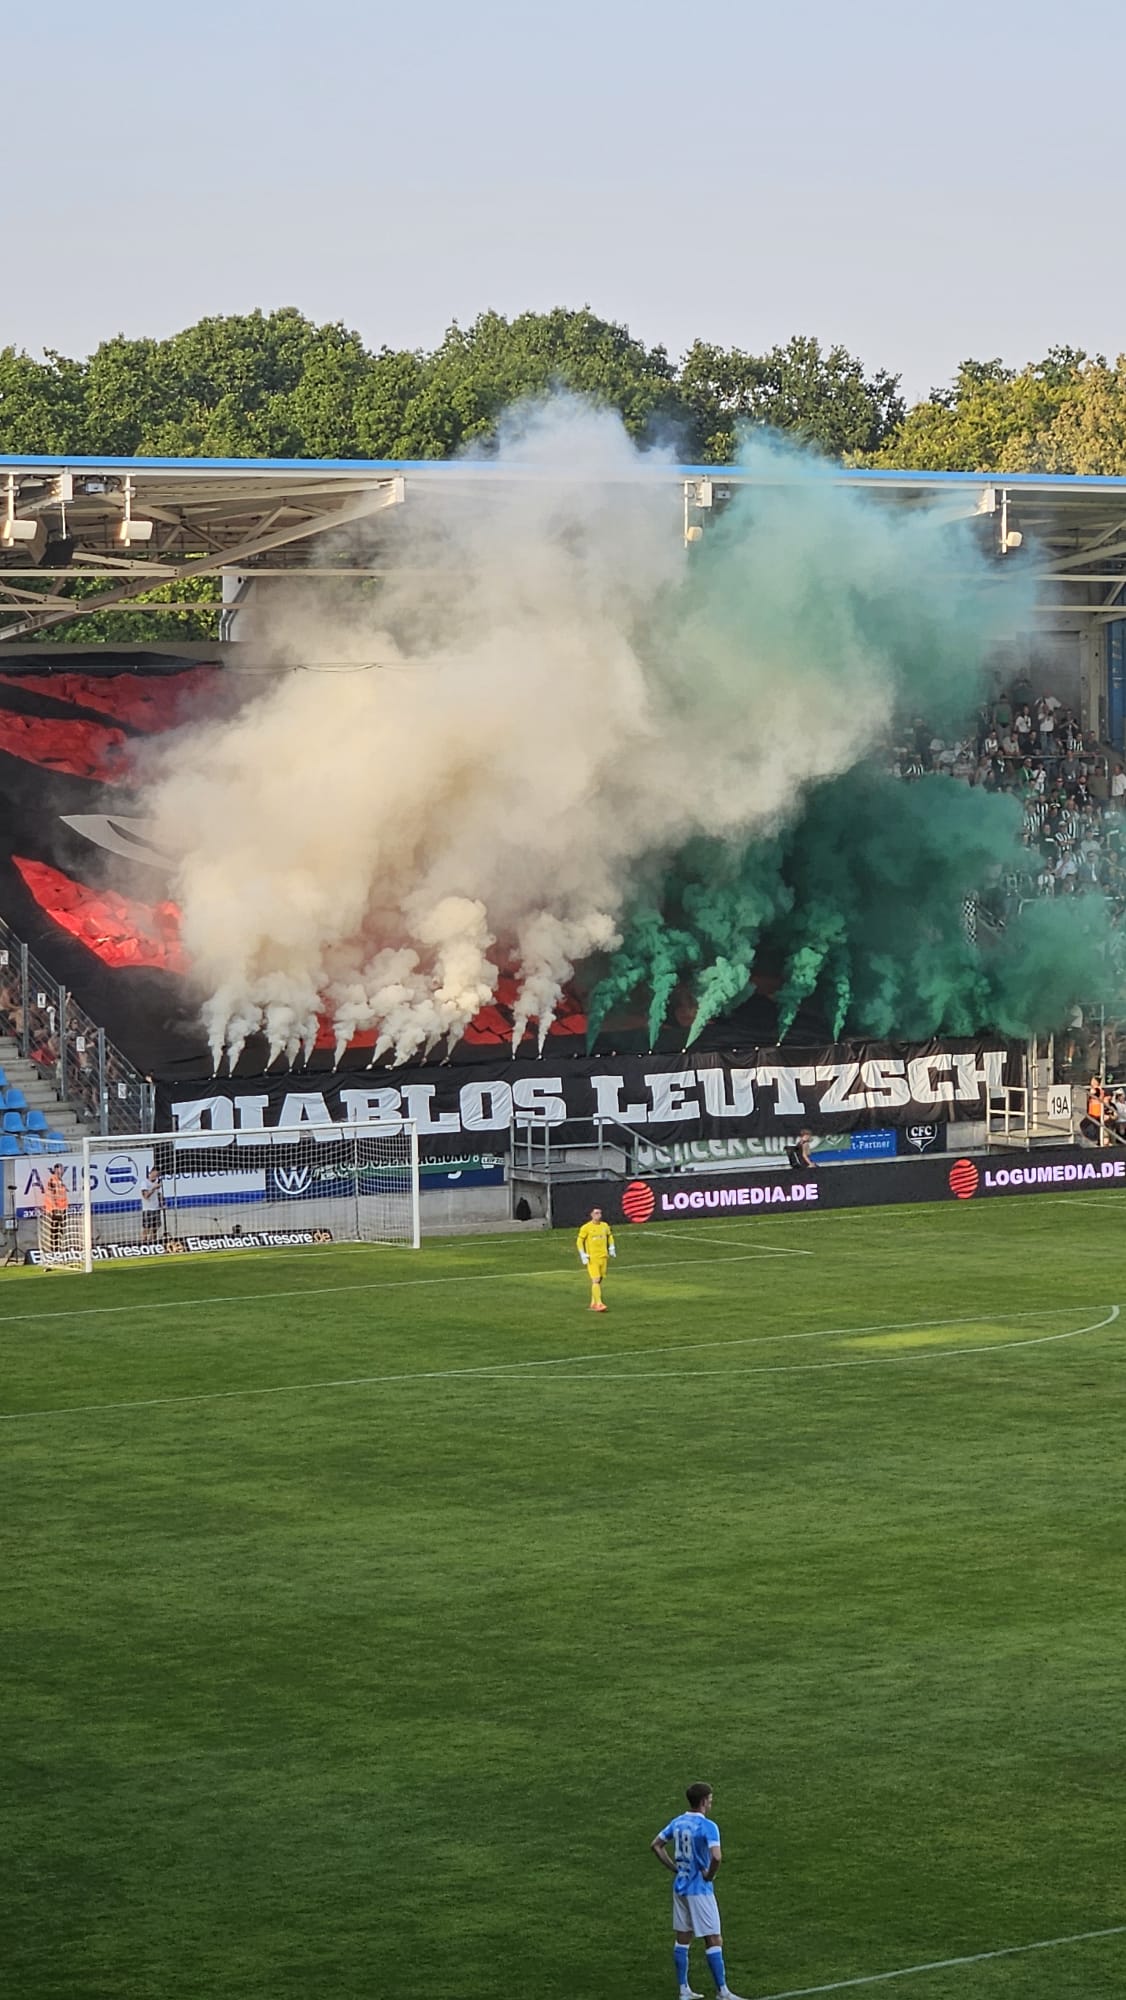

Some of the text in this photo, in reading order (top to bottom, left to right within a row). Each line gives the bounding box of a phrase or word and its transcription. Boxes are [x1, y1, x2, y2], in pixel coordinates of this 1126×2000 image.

[171, 1051, 1007, 1149] DIABLOS LEUTZSCH
[1051, 1096, 1069, 1115] 19A
[910, 1125, 932, 1137] CFC
[985, 1161, 1126, 1187] LOGUMEDIA.DE
[662, 1183, 819, 1210] LOGUMEDIA.DE
[186, 1233, 260, 1251] Eisenbach
[259, 1231, 313, 1246] Tresore
[673, 1828, 693, 1860] 18
